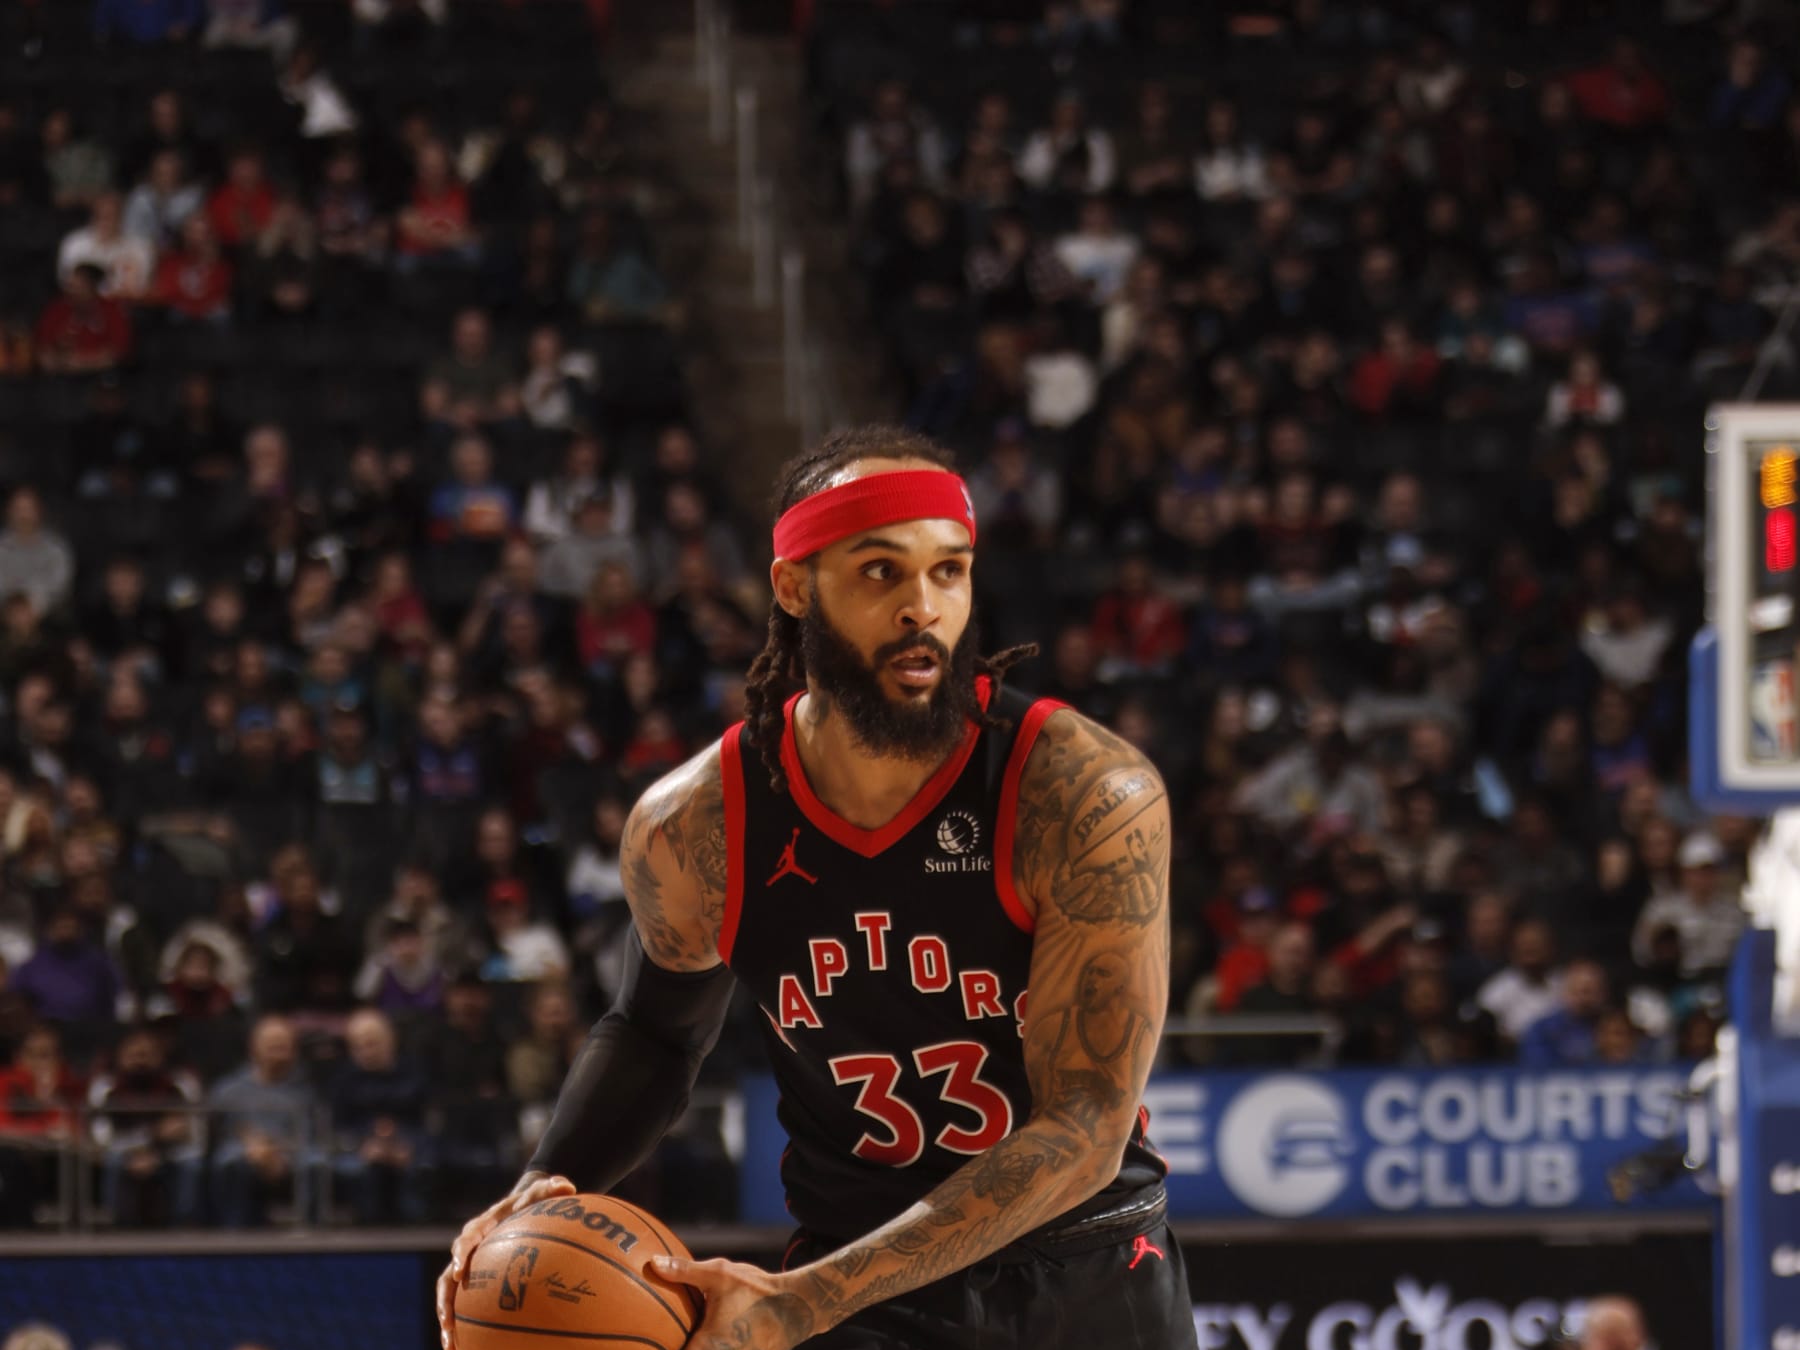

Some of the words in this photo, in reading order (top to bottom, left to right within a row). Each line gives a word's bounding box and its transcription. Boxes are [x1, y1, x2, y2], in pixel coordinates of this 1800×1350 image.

[924, 858, 957, 873] Sun
[961, 855, 992, 872] Life
[759, 912, 1028, 1053] APTOR
[827, 1041, 1013, 1168] 33
[1363, 1145, 1582, 1211] CLUB
